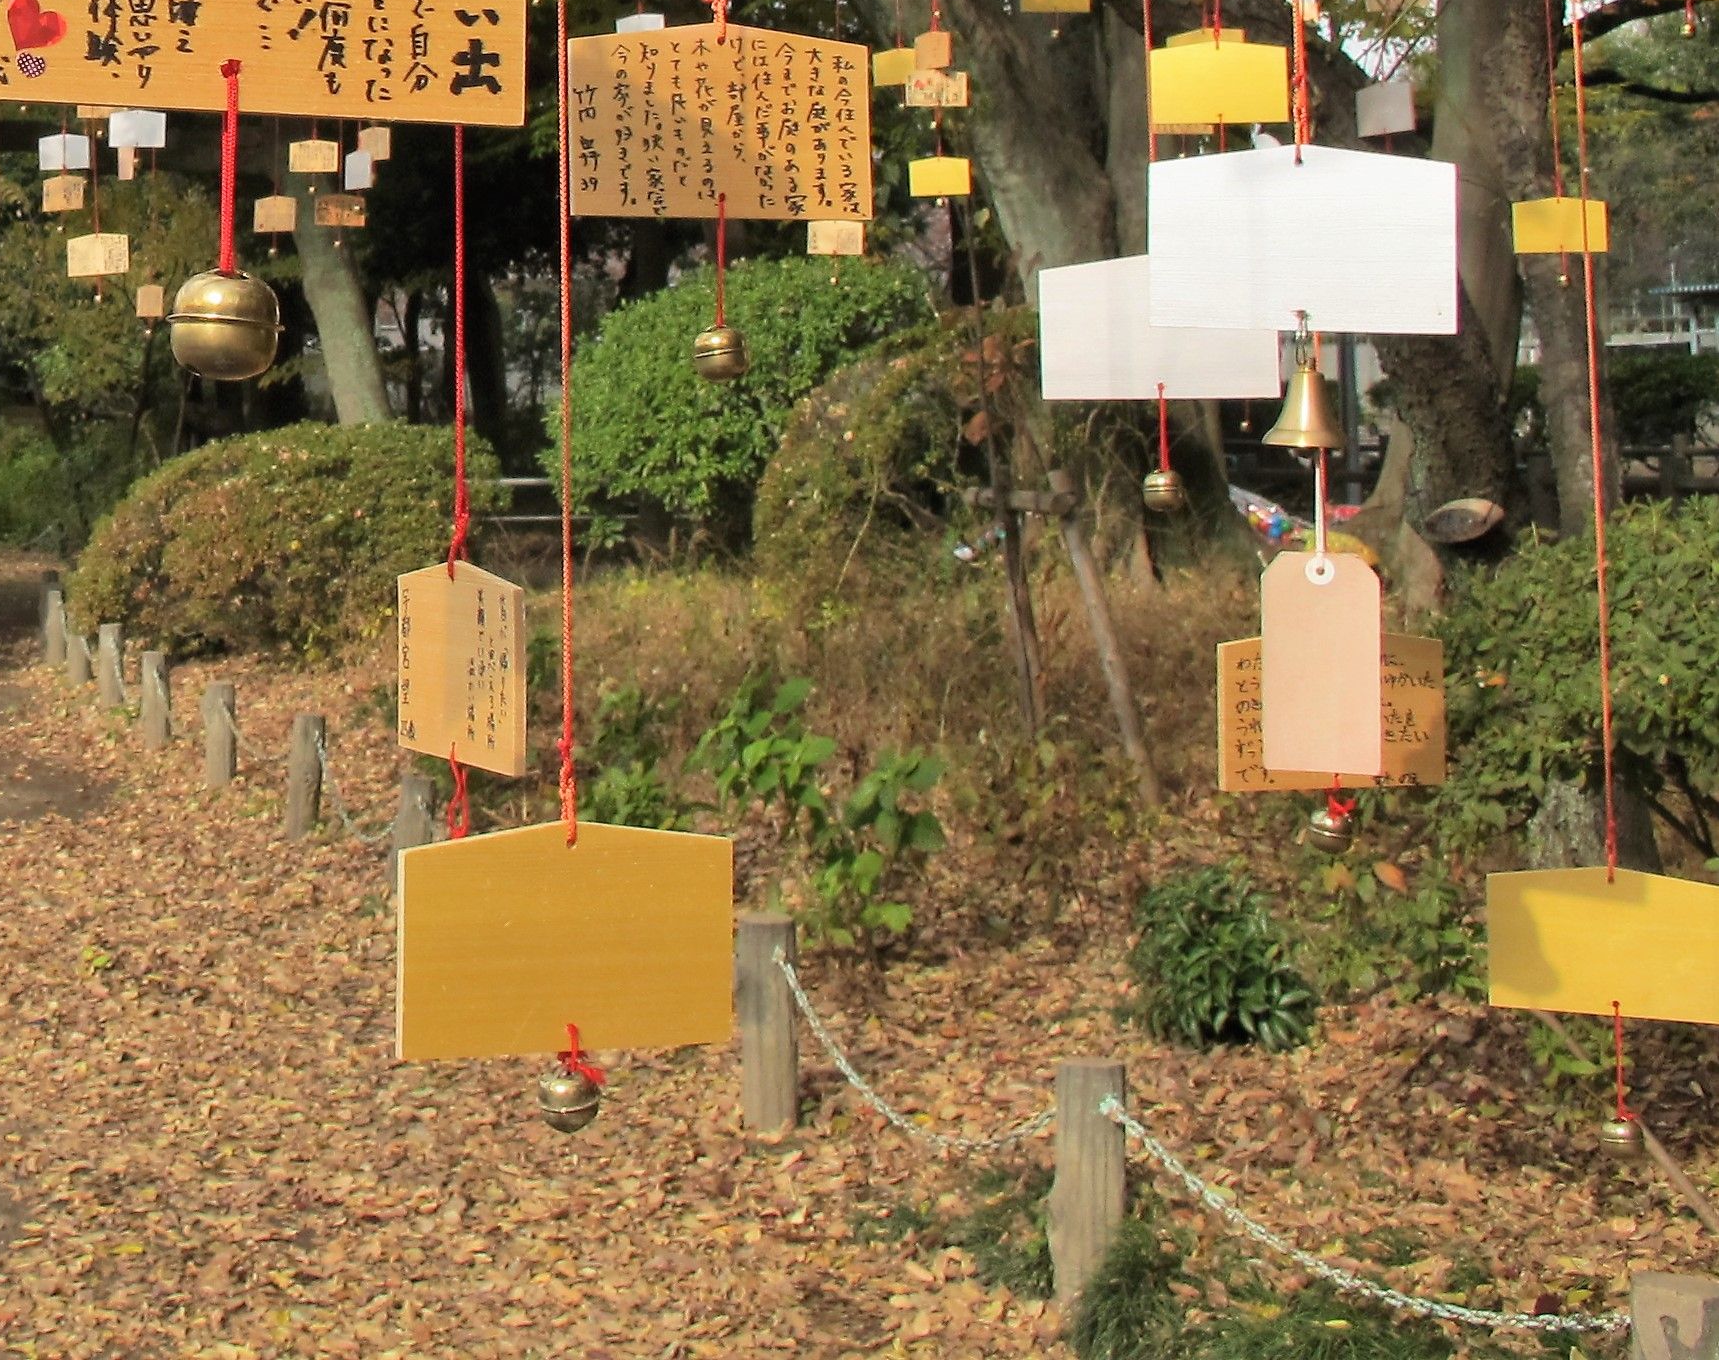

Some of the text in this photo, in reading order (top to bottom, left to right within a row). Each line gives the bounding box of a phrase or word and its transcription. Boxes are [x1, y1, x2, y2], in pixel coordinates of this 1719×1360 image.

[610, 43, 638, 207] 今の家が好きです。
[668, 41, 692, 188] とても良いものだと
[774, 42, 808, 218] 今までお庭のある家
[804, 47, 832, 208] 大きな庭があります。
[831, 54, 867, 218] 私の今住んでいる家は、
